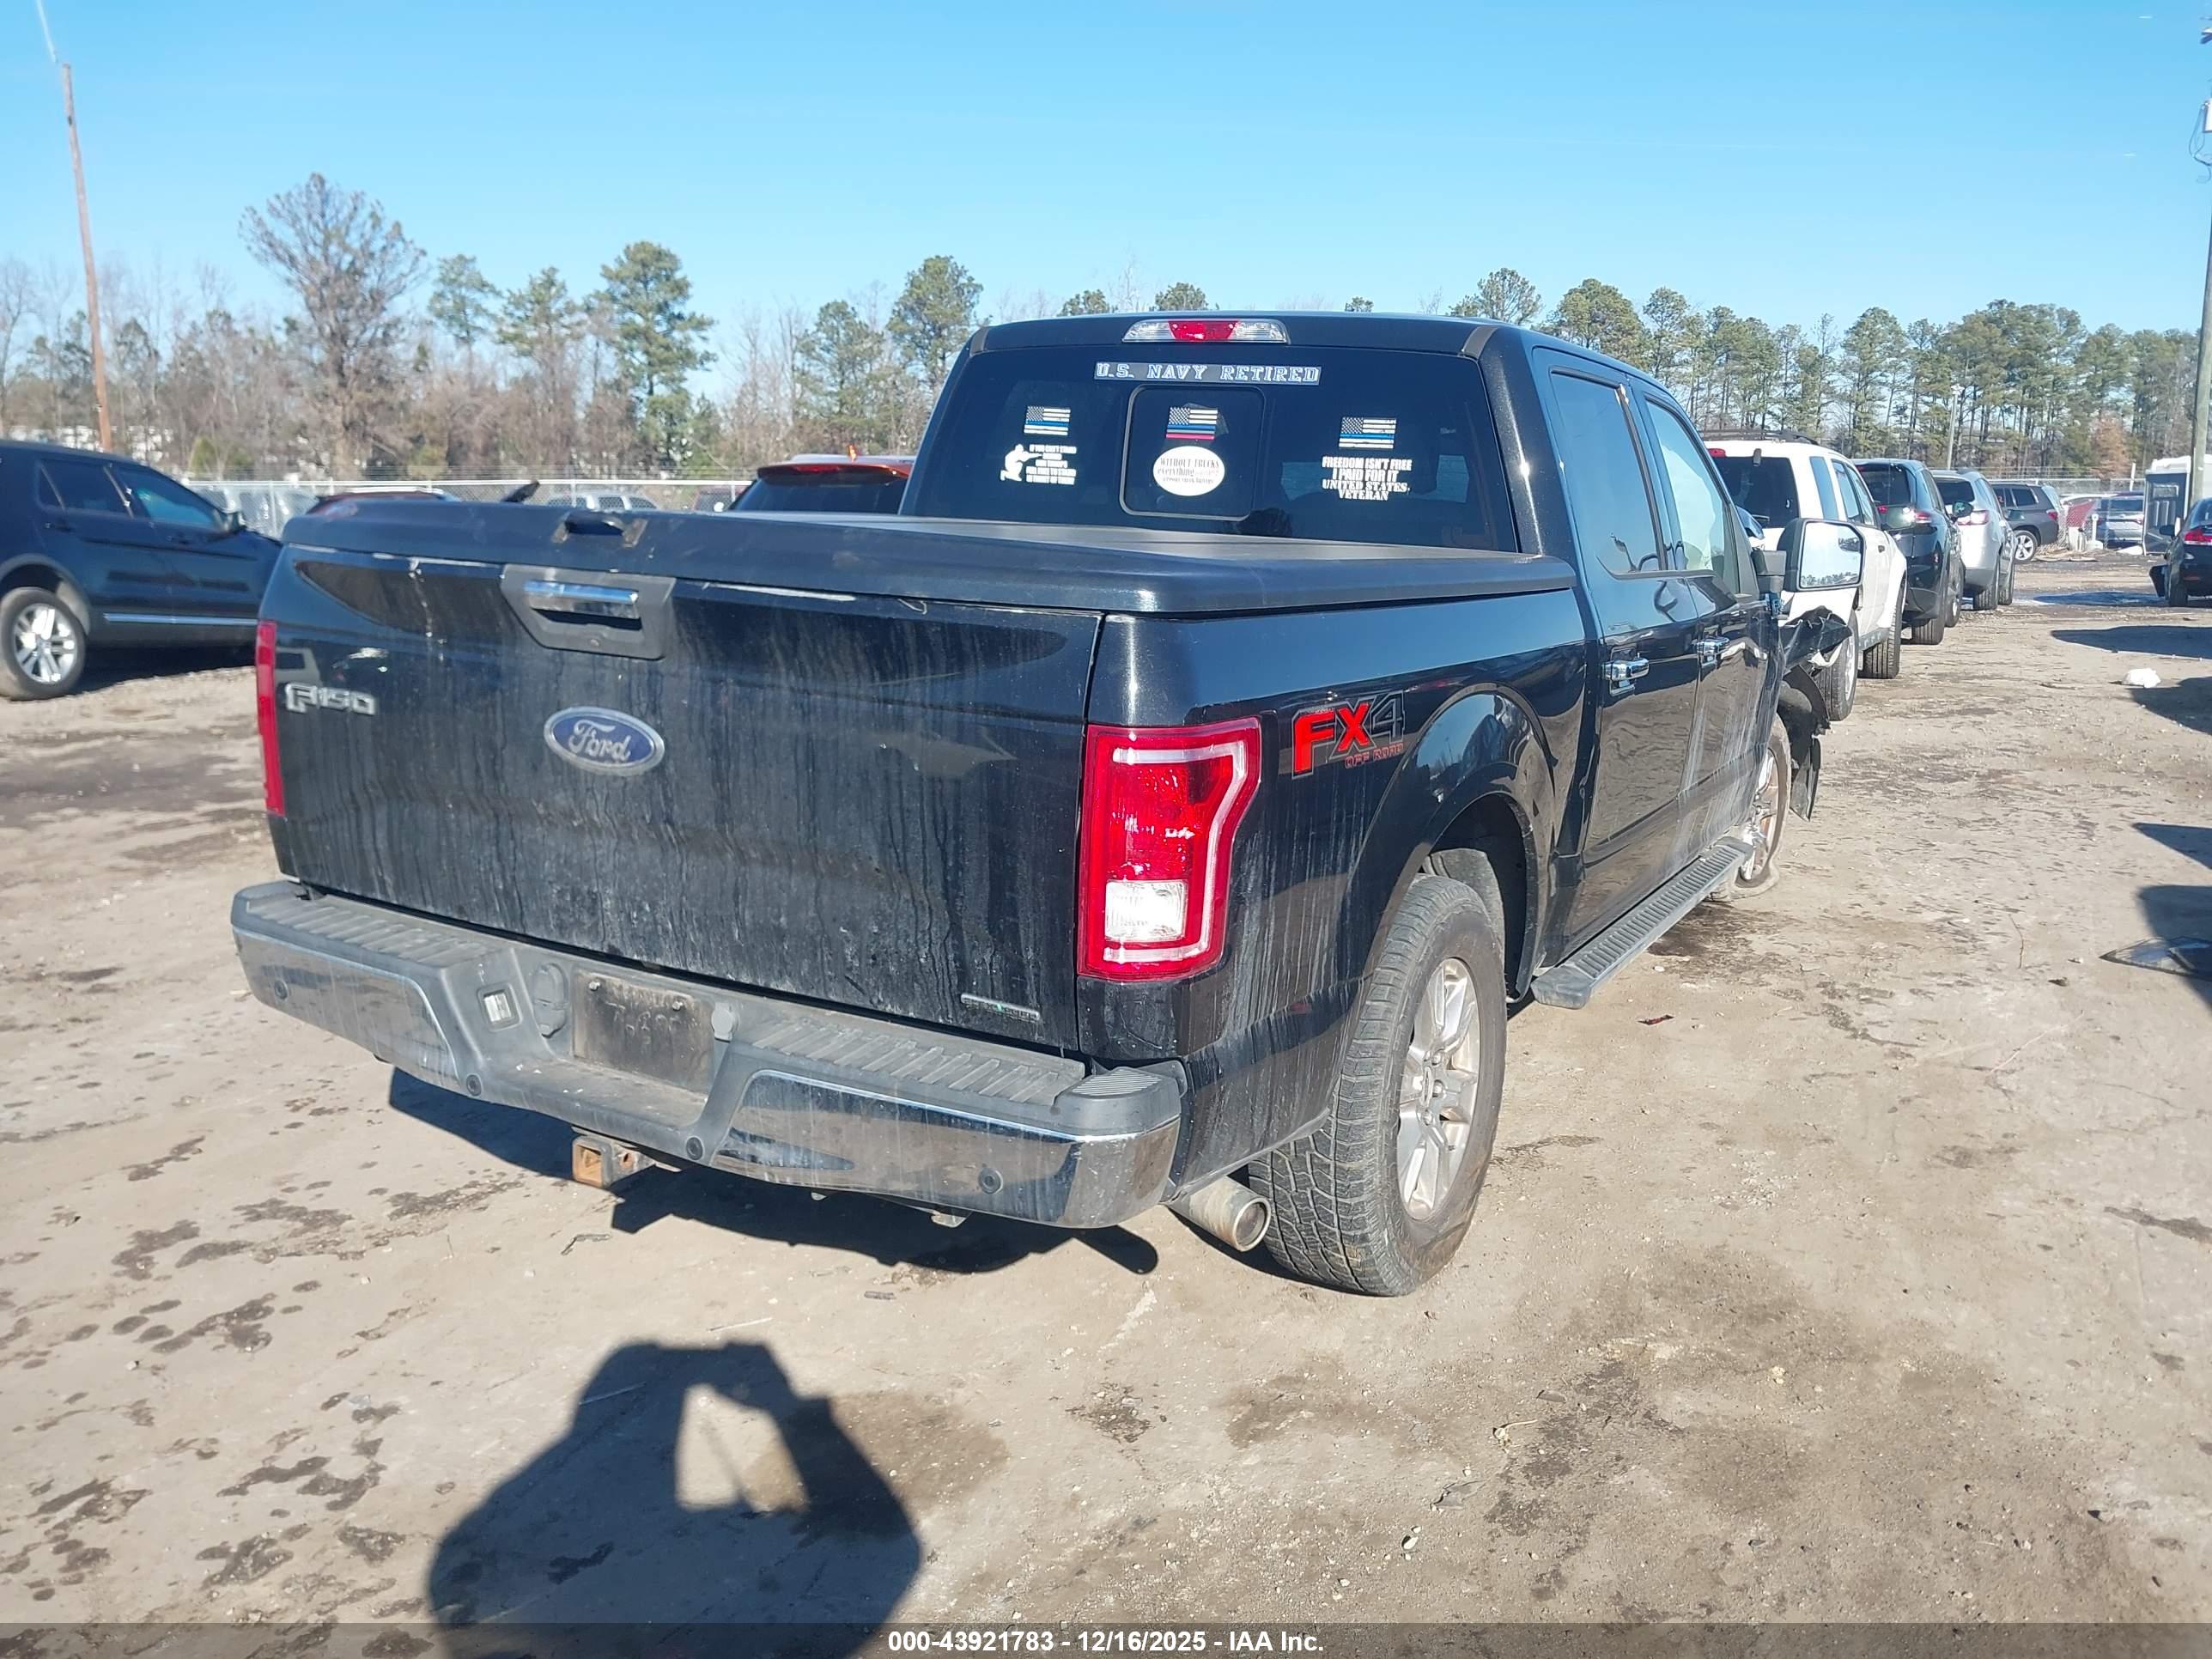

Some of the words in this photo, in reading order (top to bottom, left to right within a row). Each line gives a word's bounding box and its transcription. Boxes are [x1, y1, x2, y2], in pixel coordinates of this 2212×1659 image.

[1096, 363, 1134, 378] U.S.
[1147, 364, 1207, 380] NAVY
[1219, 366, 1320, 382] RETIRED
[1161, 457, 1191, 468] WITHOUT
[1194, 459, 1219, 468] TRUCKS
[1322, 456, 1364, 469] FREEDOM
[1364, 458, 1389, 471] ISN'T
[1390, 459, 1413, 471] FREE
[1333, 468, 1339, 480] I
[1339, 468, 1364, 481] PAID
[1364, 469, 1387, 482] FOR
[1387, 470, 1400, 483] IT
[1322, 479, 1364, 490] UNITED
[1339, 489, 1389, 501] VETERAN
[568, 719, 632, 763] Ford
[1291, 690, 1406, 780] FX4
[1345, 750, 1370, 769] OFF
[1373, 742, 1404, 761] ROAD
